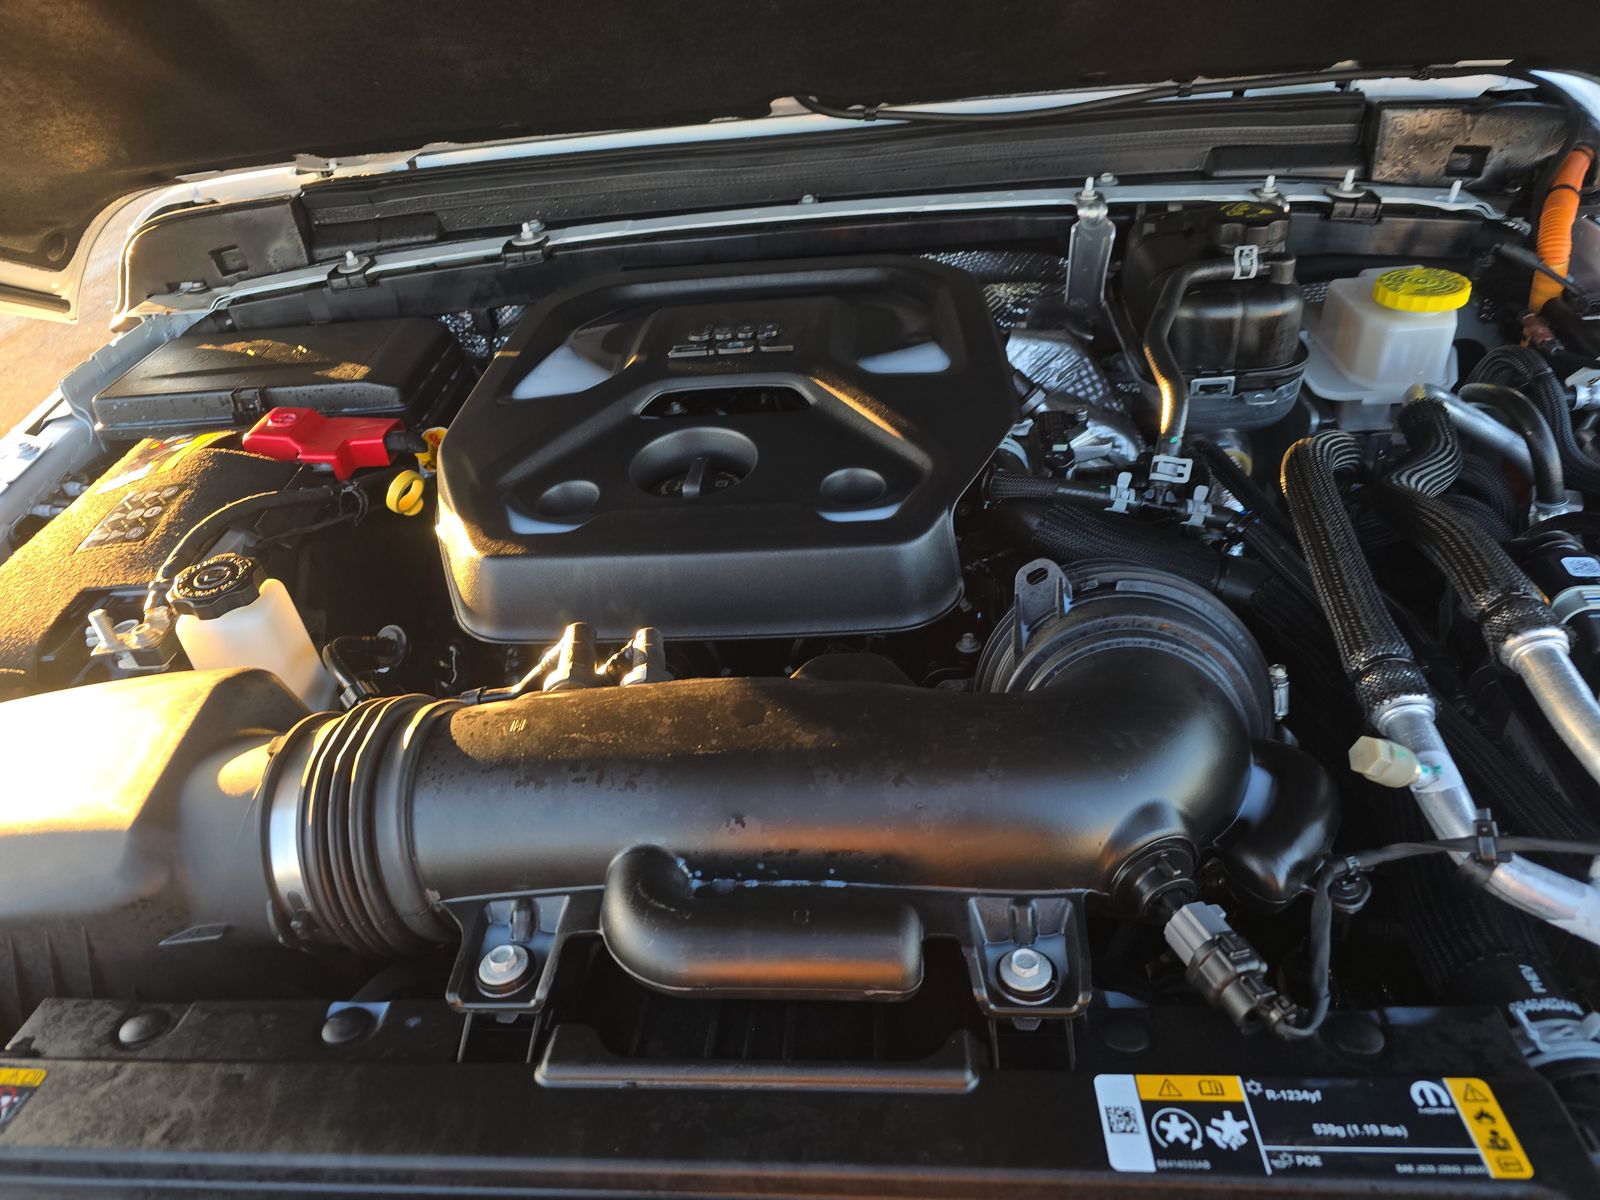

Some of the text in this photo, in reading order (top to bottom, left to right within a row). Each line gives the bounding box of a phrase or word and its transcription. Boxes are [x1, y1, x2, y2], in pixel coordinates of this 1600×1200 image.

[1265, 1088, 1322, 1104] R-1234yf
[1380, 1123, 1409, 1139] lbs)
[1295, 1154, 1323, 1167] POE
